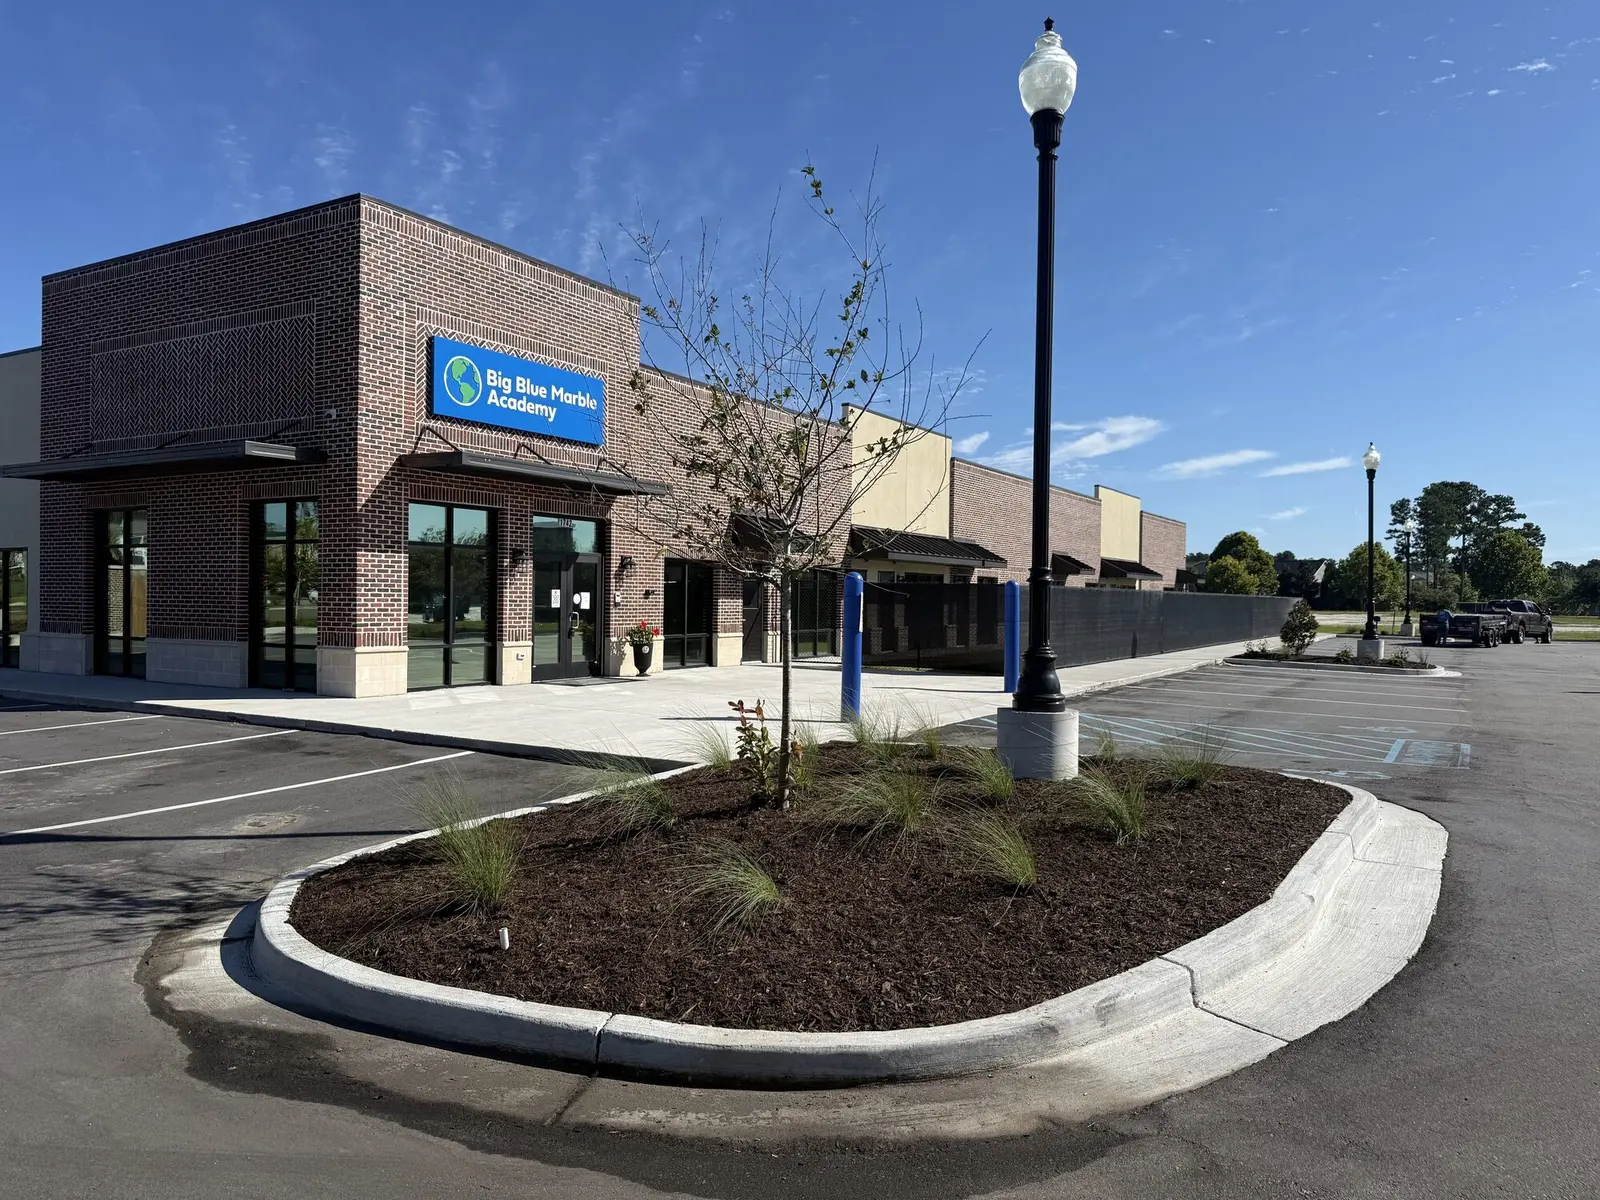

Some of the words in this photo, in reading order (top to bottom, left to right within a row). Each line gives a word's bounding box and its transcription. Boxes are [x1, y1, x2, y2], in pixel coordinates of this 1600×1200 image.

[486, 369, 512, 394] Big
[515, 376, 547, 398] Blue
[551, 385, 597, 410] Marble
[487, 389, 557, 422] Academy
